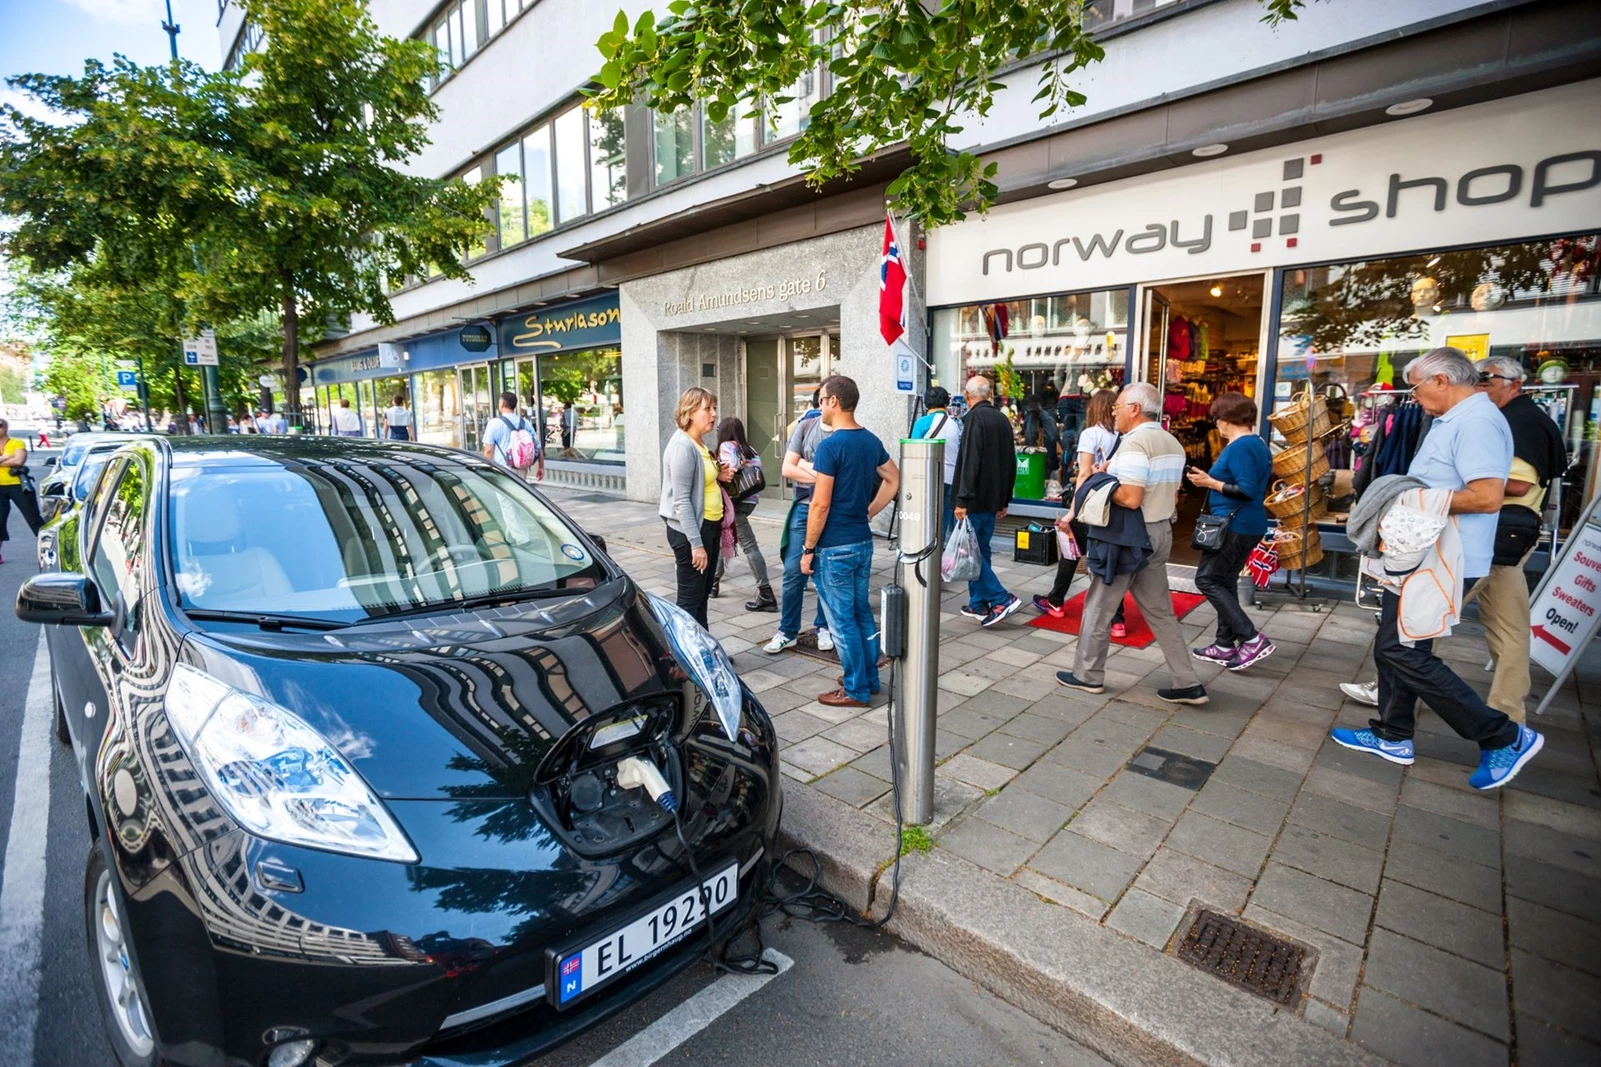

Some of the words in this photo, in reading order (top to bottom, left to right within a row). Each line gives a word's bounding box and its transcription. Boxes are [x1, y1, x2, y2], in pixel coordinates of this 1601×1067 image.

[982, 213, 1214, 276] norway
[1328, 150, 1601, 227] shop
[664, 299, 695, 316] Roald
[698, 285, 775, 311] Amundsens
[779, 279, 812, 302] gate
[815, 269, 828, 292] 6
[512, 307, 621, 349] Sturlason
[121, 373, 132, 384] P
[898, 510, 921, 521] 0049
[1574, 574, 1597, 593] Gifts
[1552, 586, 1596, 617] Sweaters
[1545, 607, 1579, 634] Open!
[597, 934, 632, 977] EL
[648, 876, 728, 945] 19290
[566, 979, 577, 993] N
